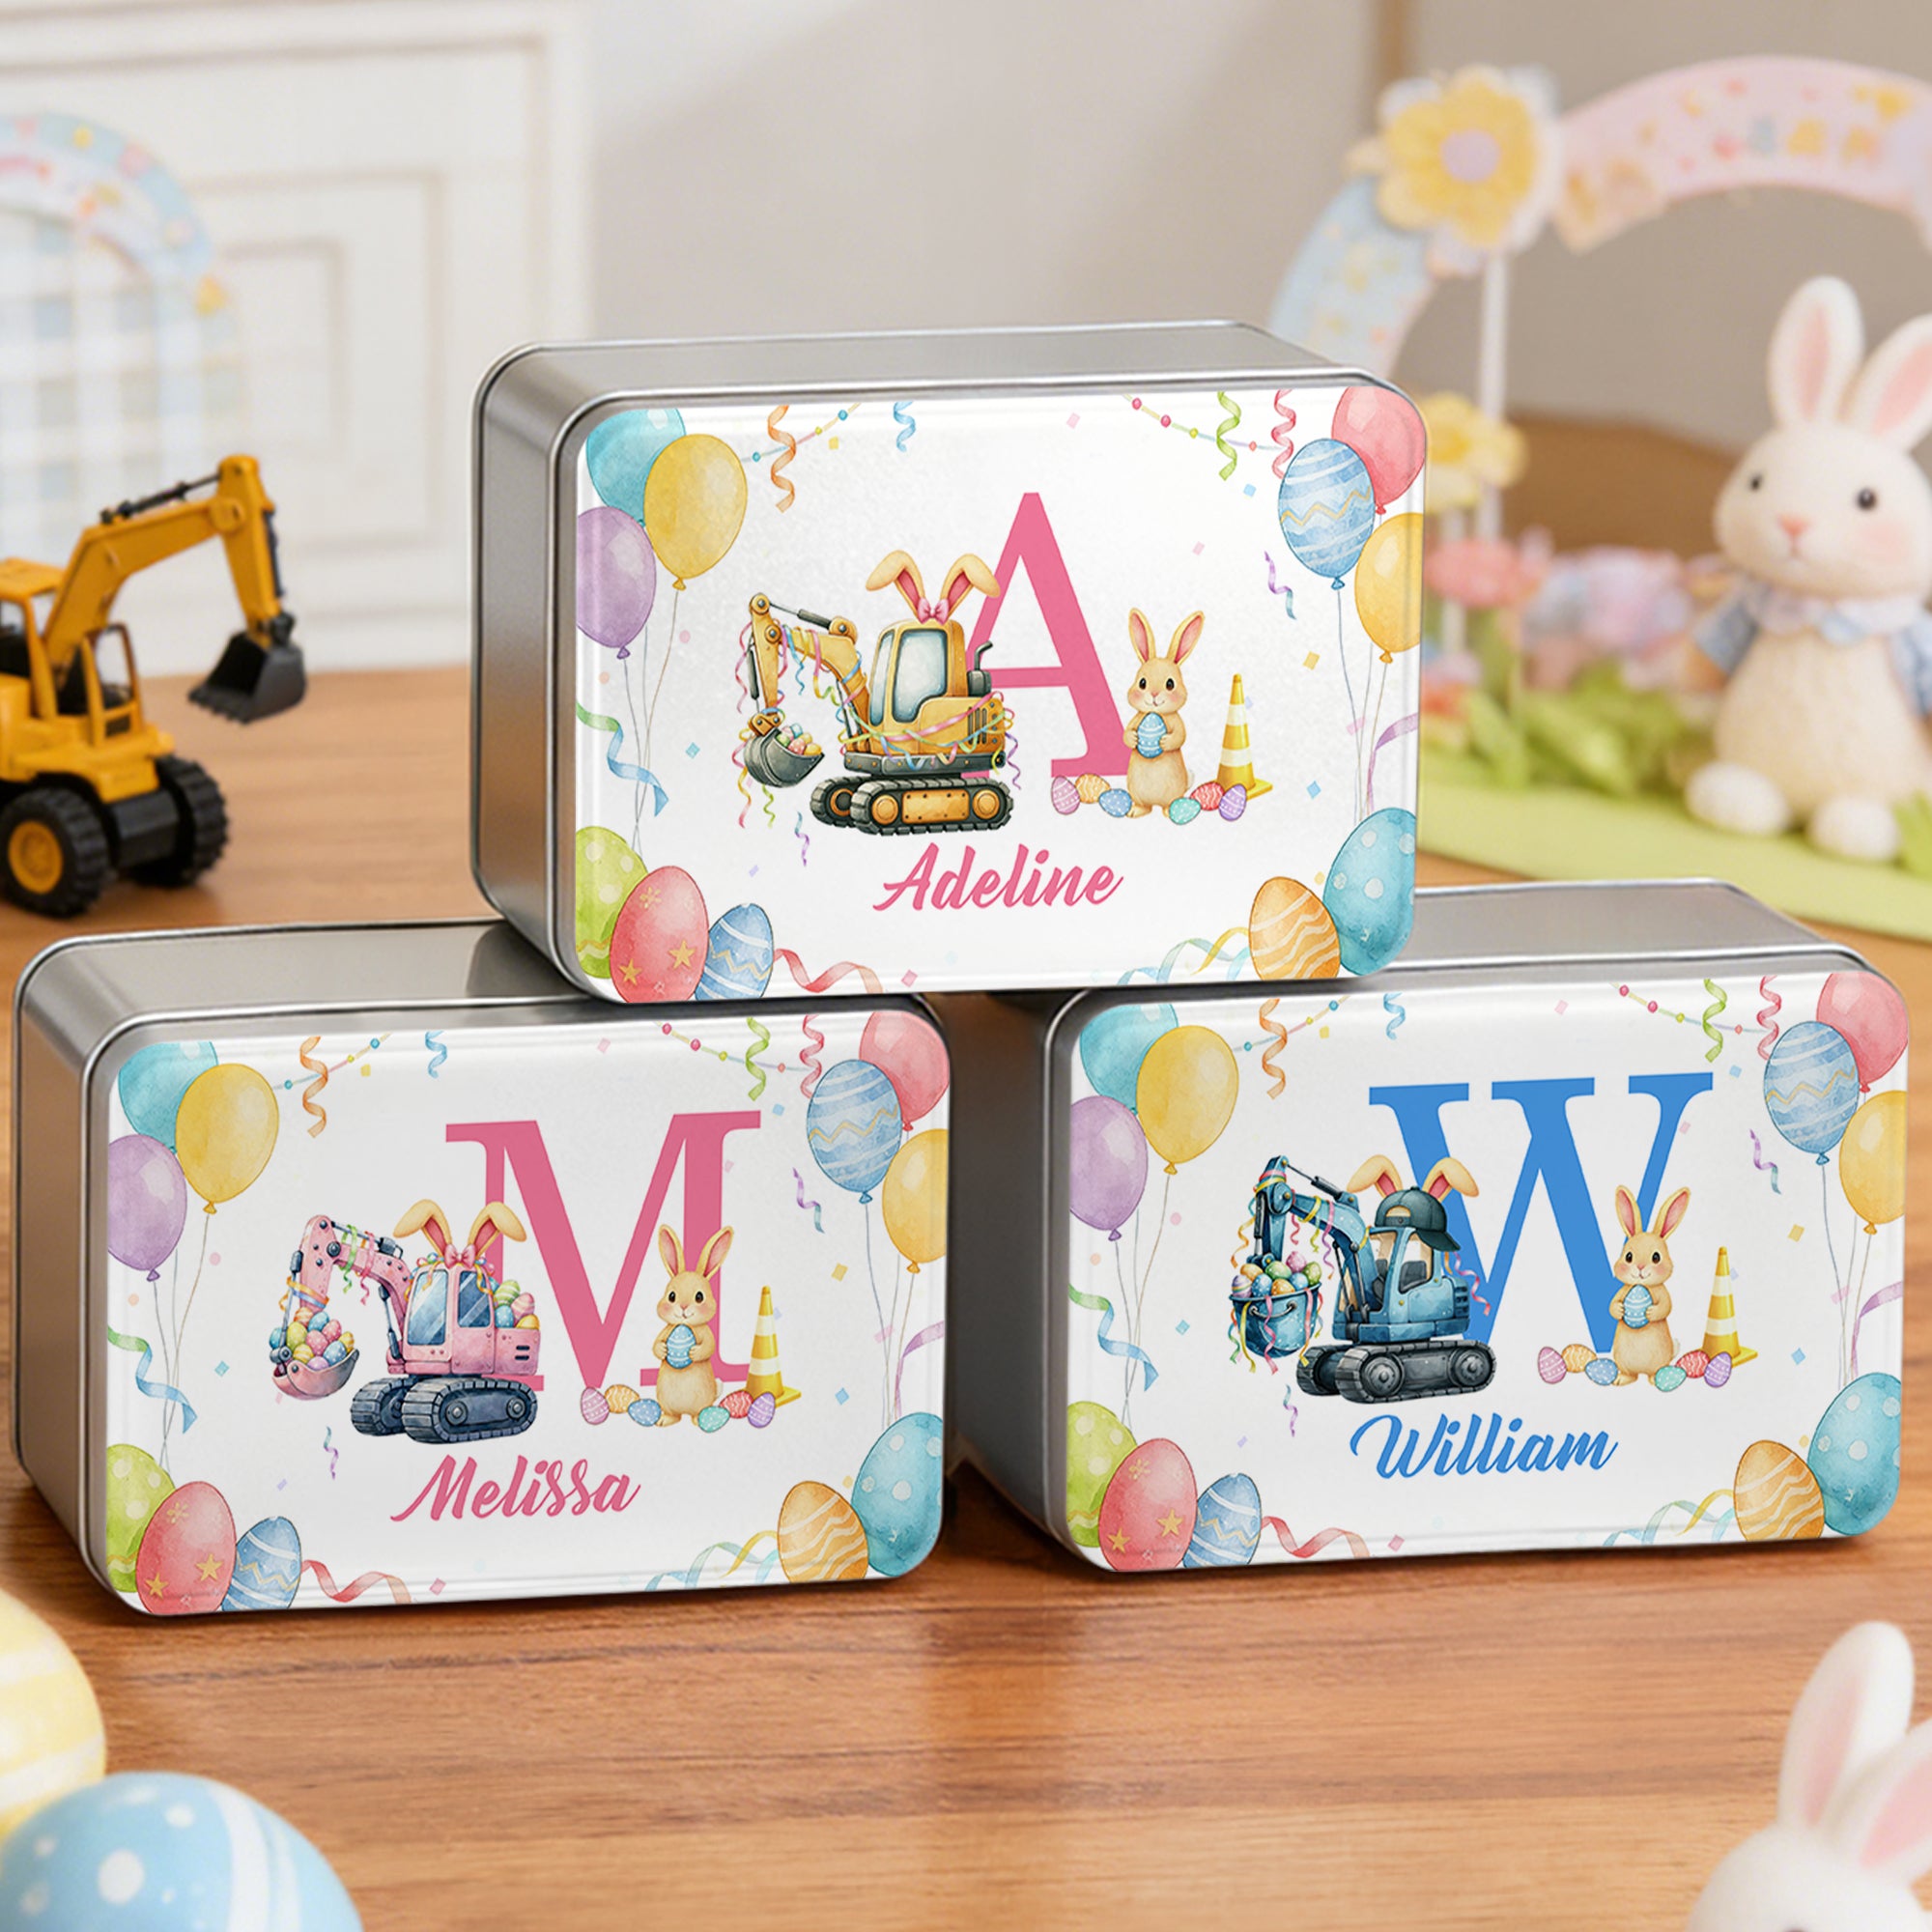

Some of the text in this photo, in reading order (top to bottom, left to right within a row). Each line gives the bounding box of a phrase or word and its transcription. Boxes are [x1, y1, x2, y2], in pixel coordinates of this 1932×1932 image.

[961, 493, 1132, 779] A
[873, 842, 1123, 911] Adeline
[446, 1111, 760, 1391] M
[1370, 1072, 1713, 1353] W
[391, 1454, 640, 1522] Melissa
[1350, 1413, 1618, 1480] William
